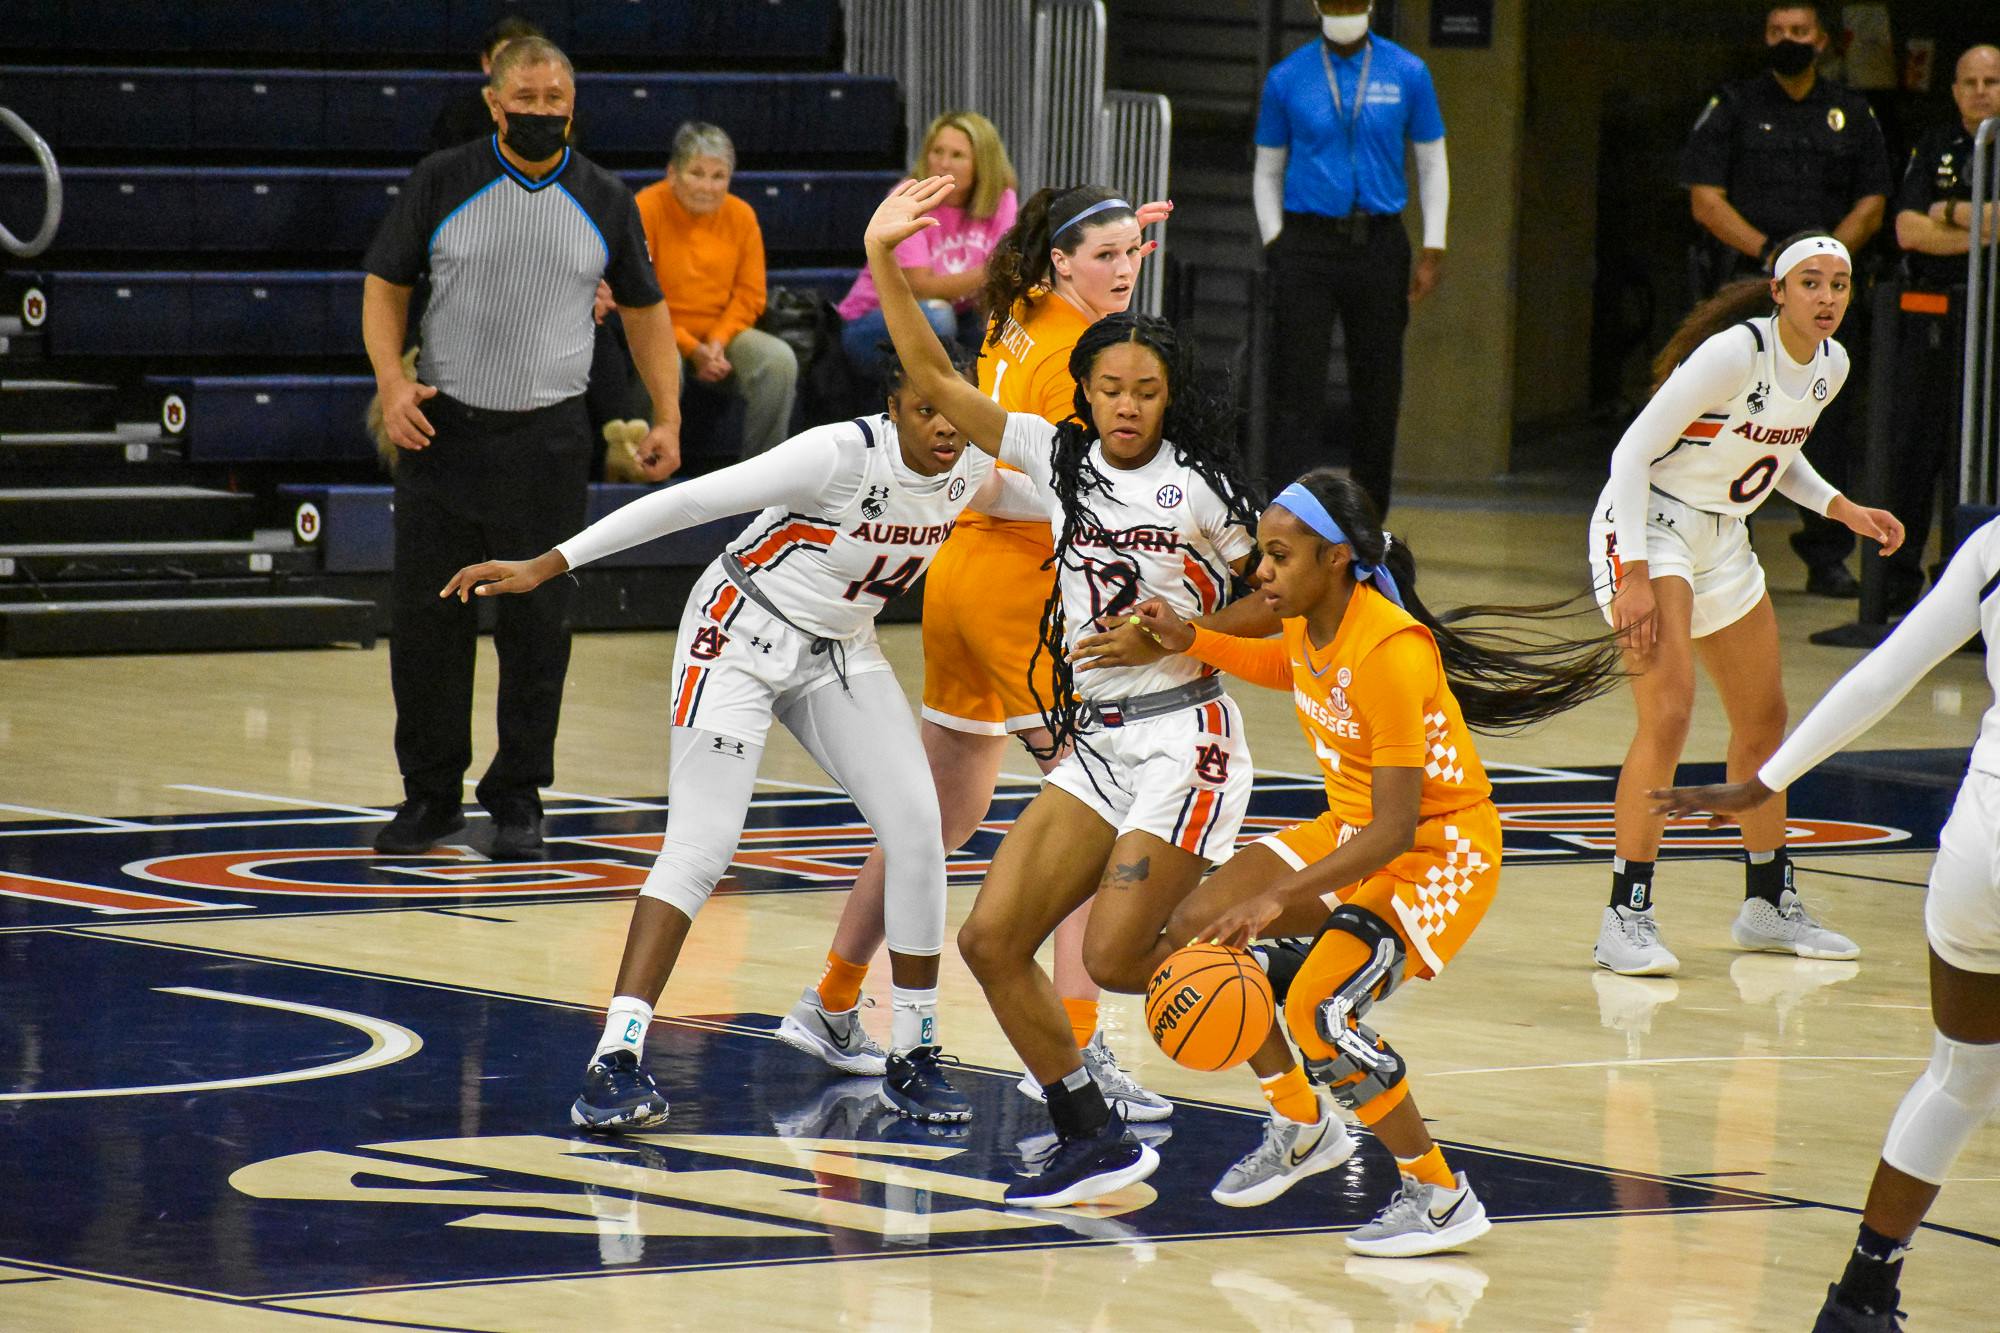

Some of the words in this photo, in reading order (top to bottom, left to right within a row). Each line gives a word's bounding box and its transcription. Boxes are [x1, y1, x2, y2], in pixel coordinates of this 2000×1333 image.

[1000, 316, 1036, 364] CKETT
[1156, 484, 1183, 508] SEC
[1729, 454, 1779, 504] 0
[849, 519, 956, 545] AUBURN
[1072, 526, 1180, 554] UBURN
[843, 555, 925, 603] 14
[1293, 682, 1360, 740] NNESSEE
